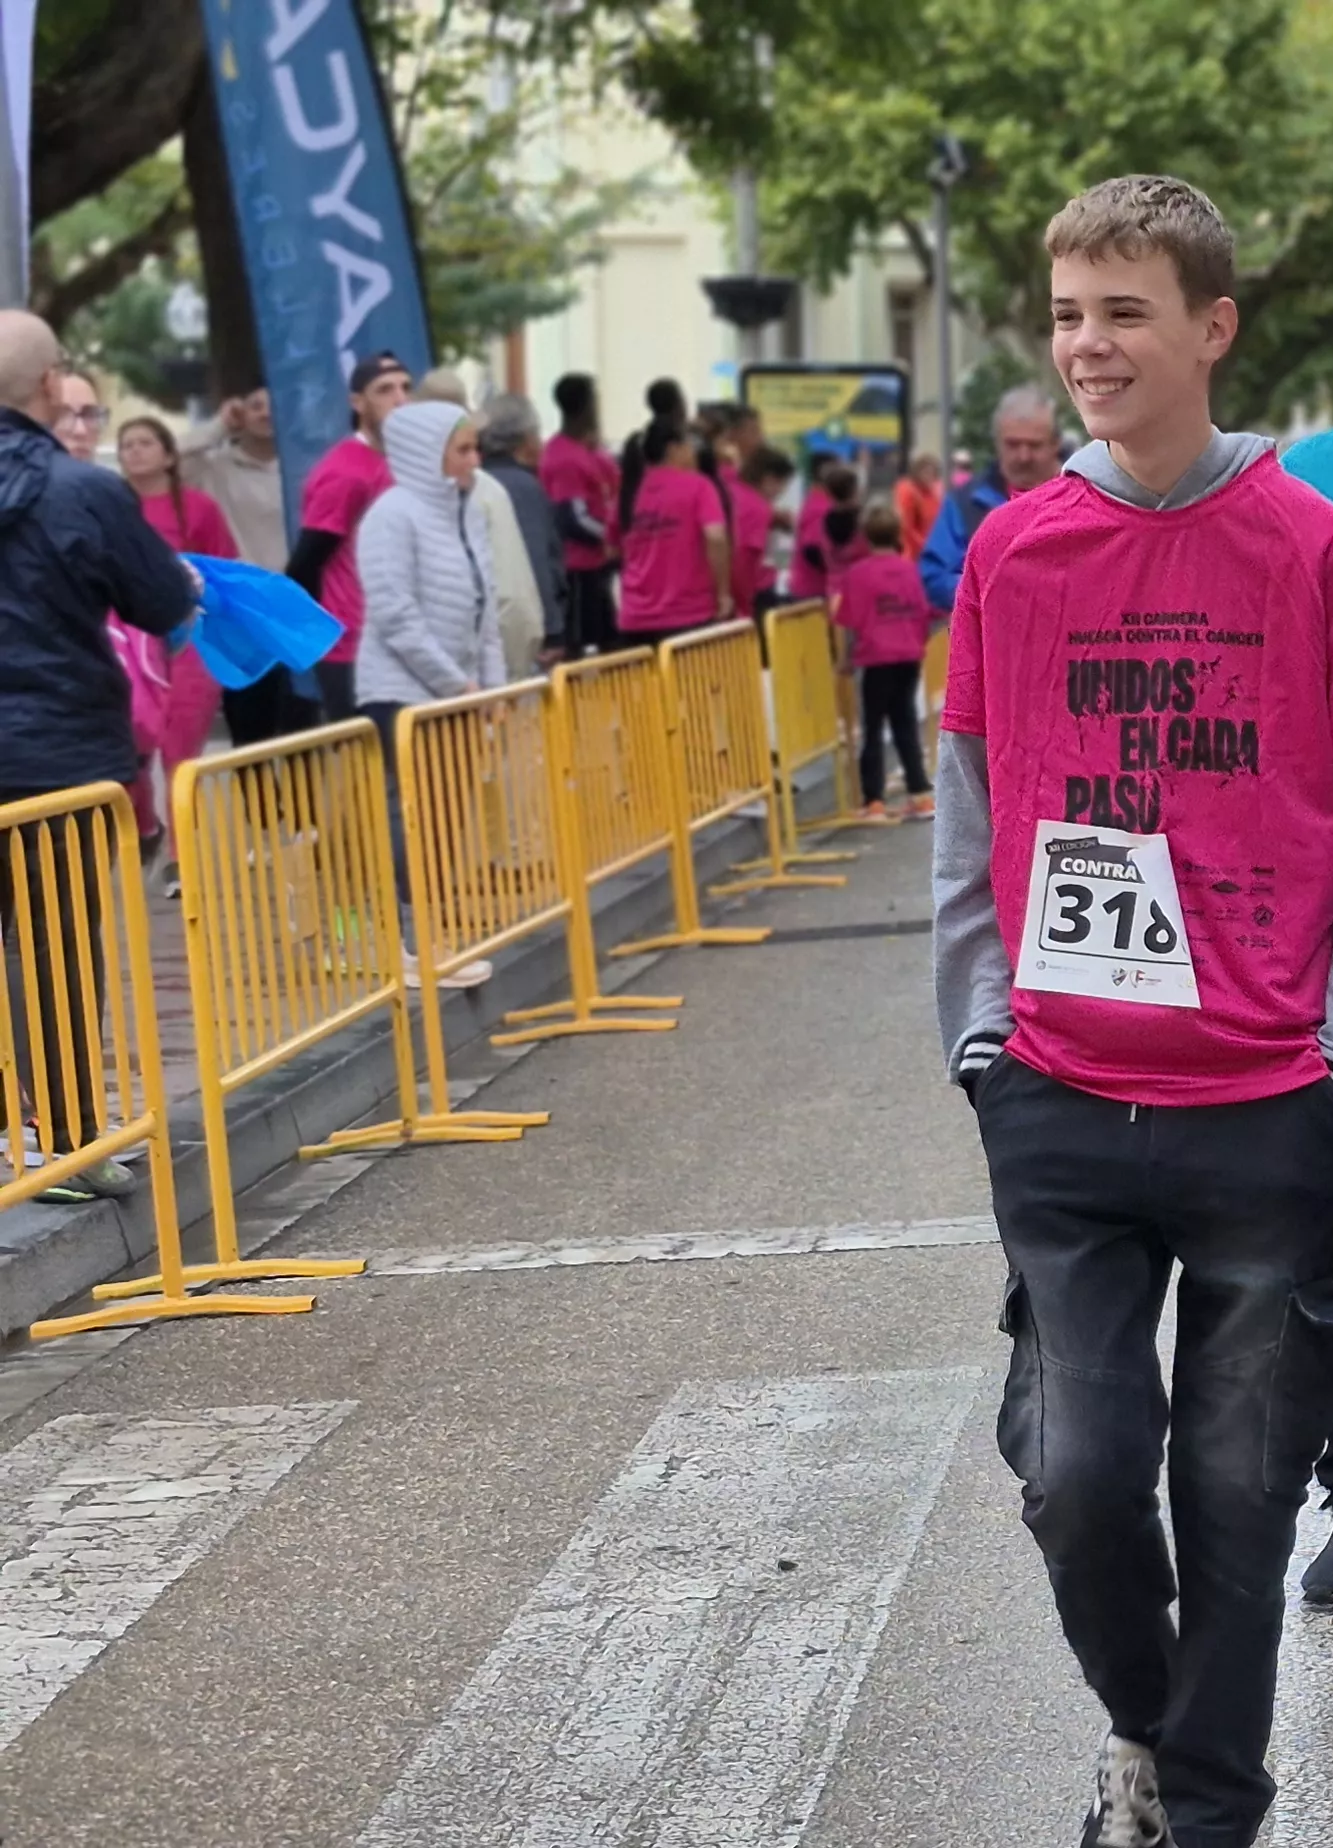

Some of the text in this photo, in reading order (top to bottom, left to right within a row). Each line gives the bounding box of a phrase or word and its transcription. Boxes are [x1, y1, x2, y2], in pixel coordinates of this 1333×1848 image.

[1126, 629, 1180, 644] CONTRA
[1185, 630, 1200, 642] EL
[1143, 611, 1209, 626] CARRERA
[1066, 657, 1197, 718] UNIDOS
[1119, 717, 1260, 776] EN CADA
[1064, 775, 1161, 834] PASO
[1060, 857, 1138, 880] CONTRA
